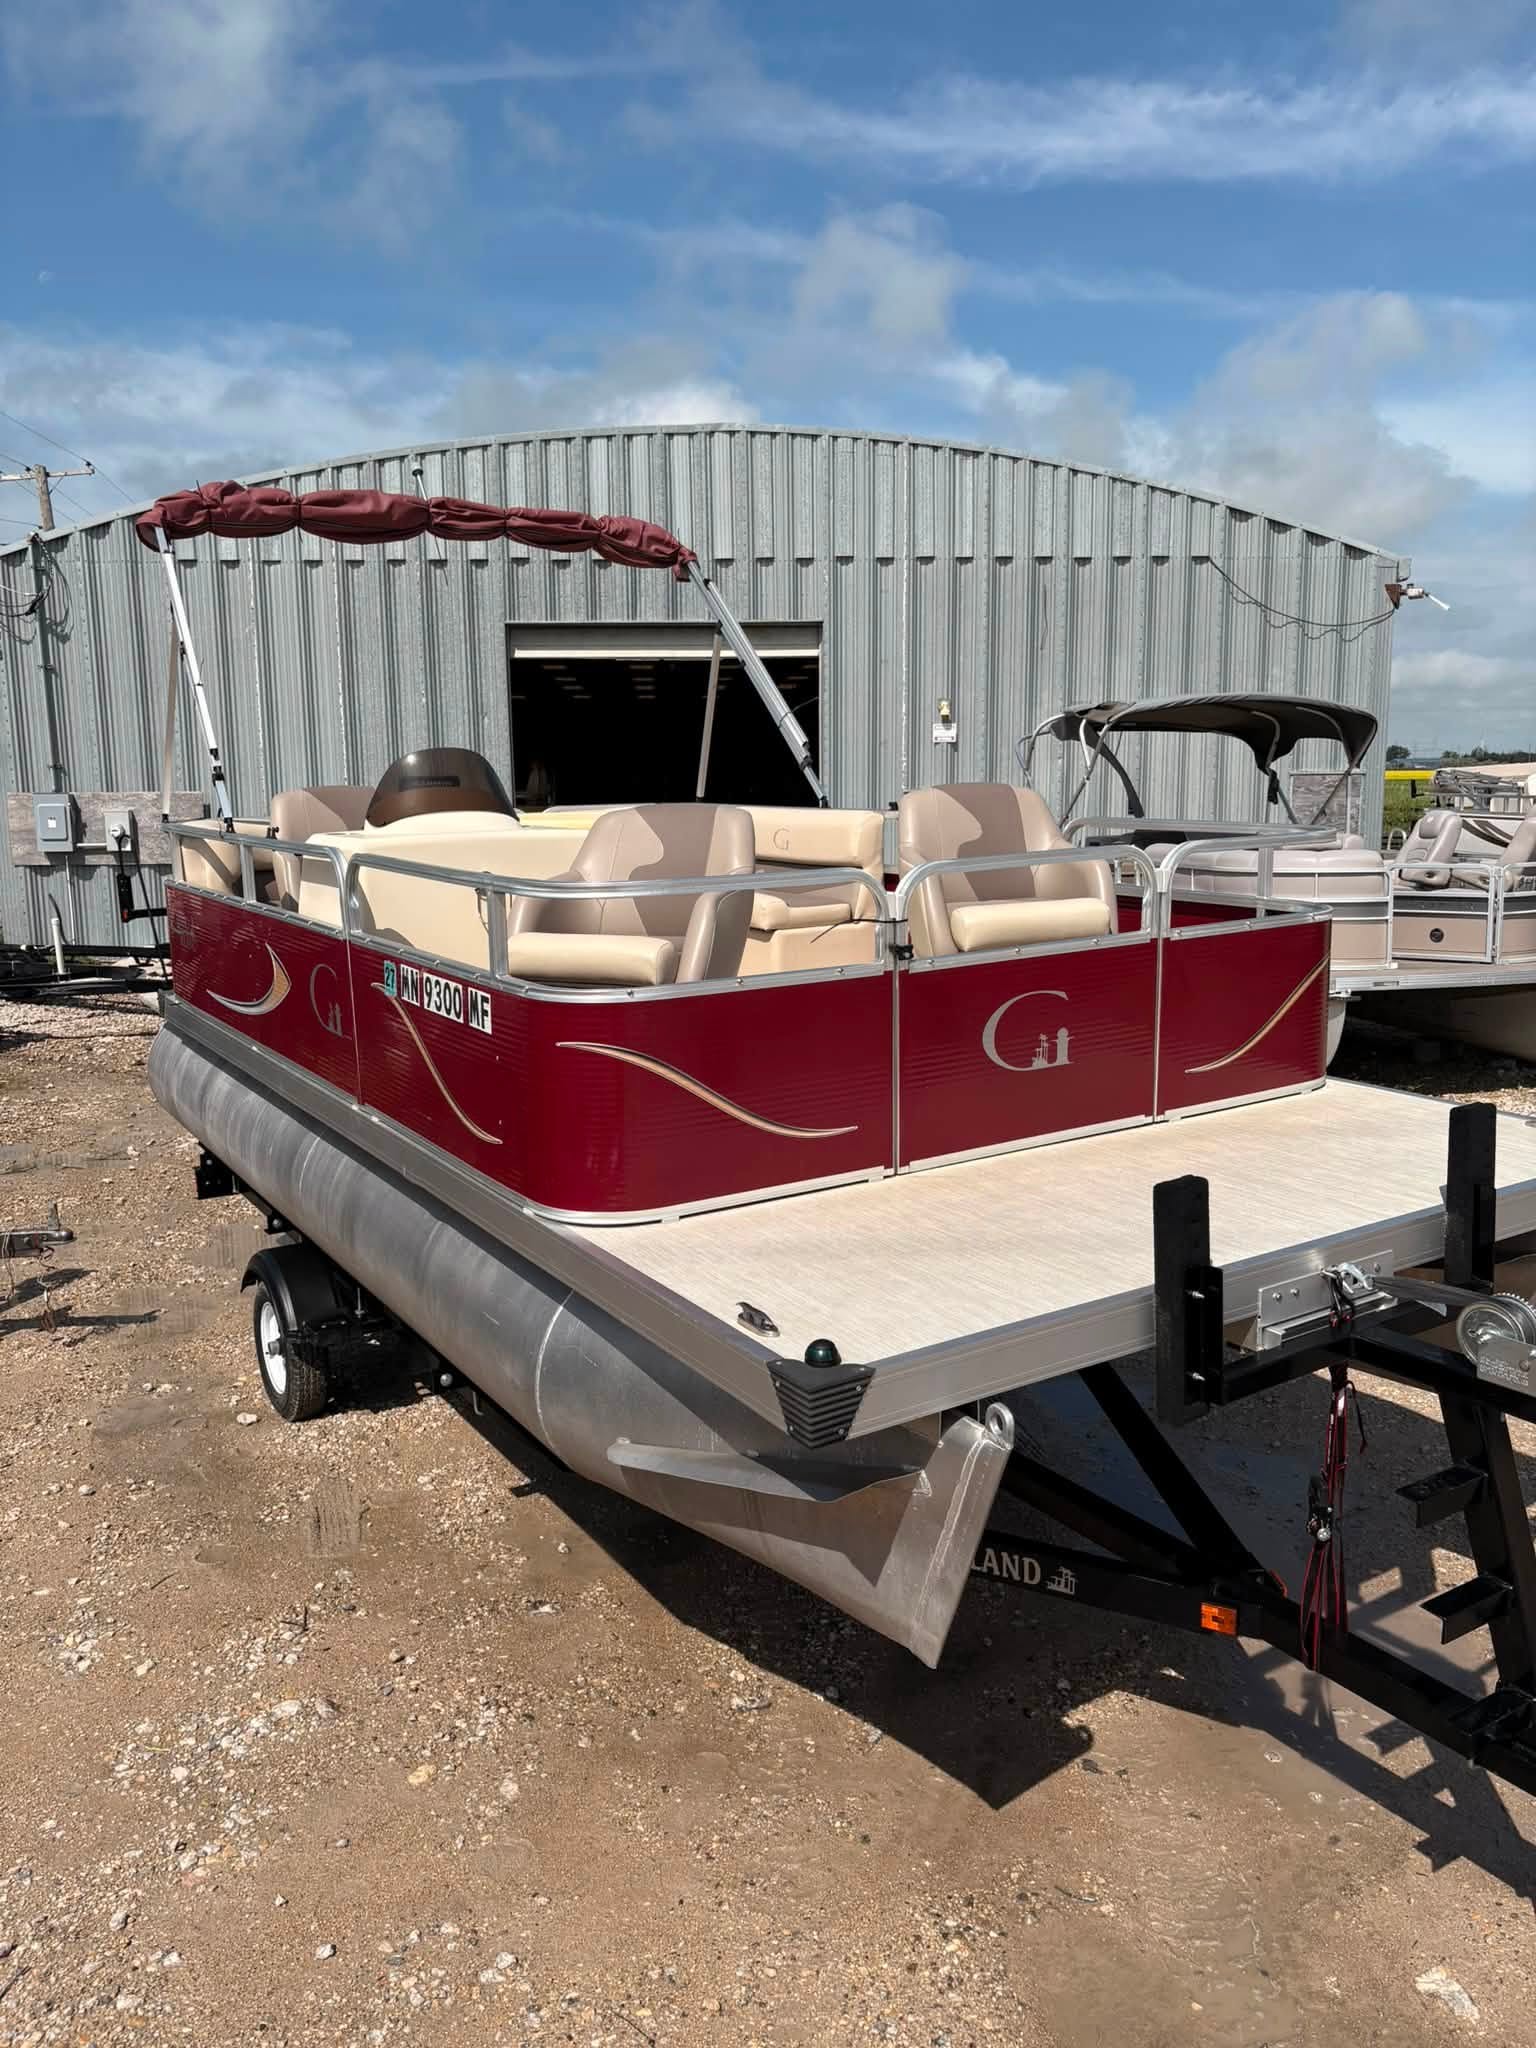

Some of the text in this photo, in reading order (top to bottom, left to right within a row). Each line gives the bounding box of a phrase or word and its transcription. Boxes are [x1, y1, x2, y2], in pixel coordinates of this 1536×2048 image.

[401, 967, 490, 1030] MN 9300 MF
